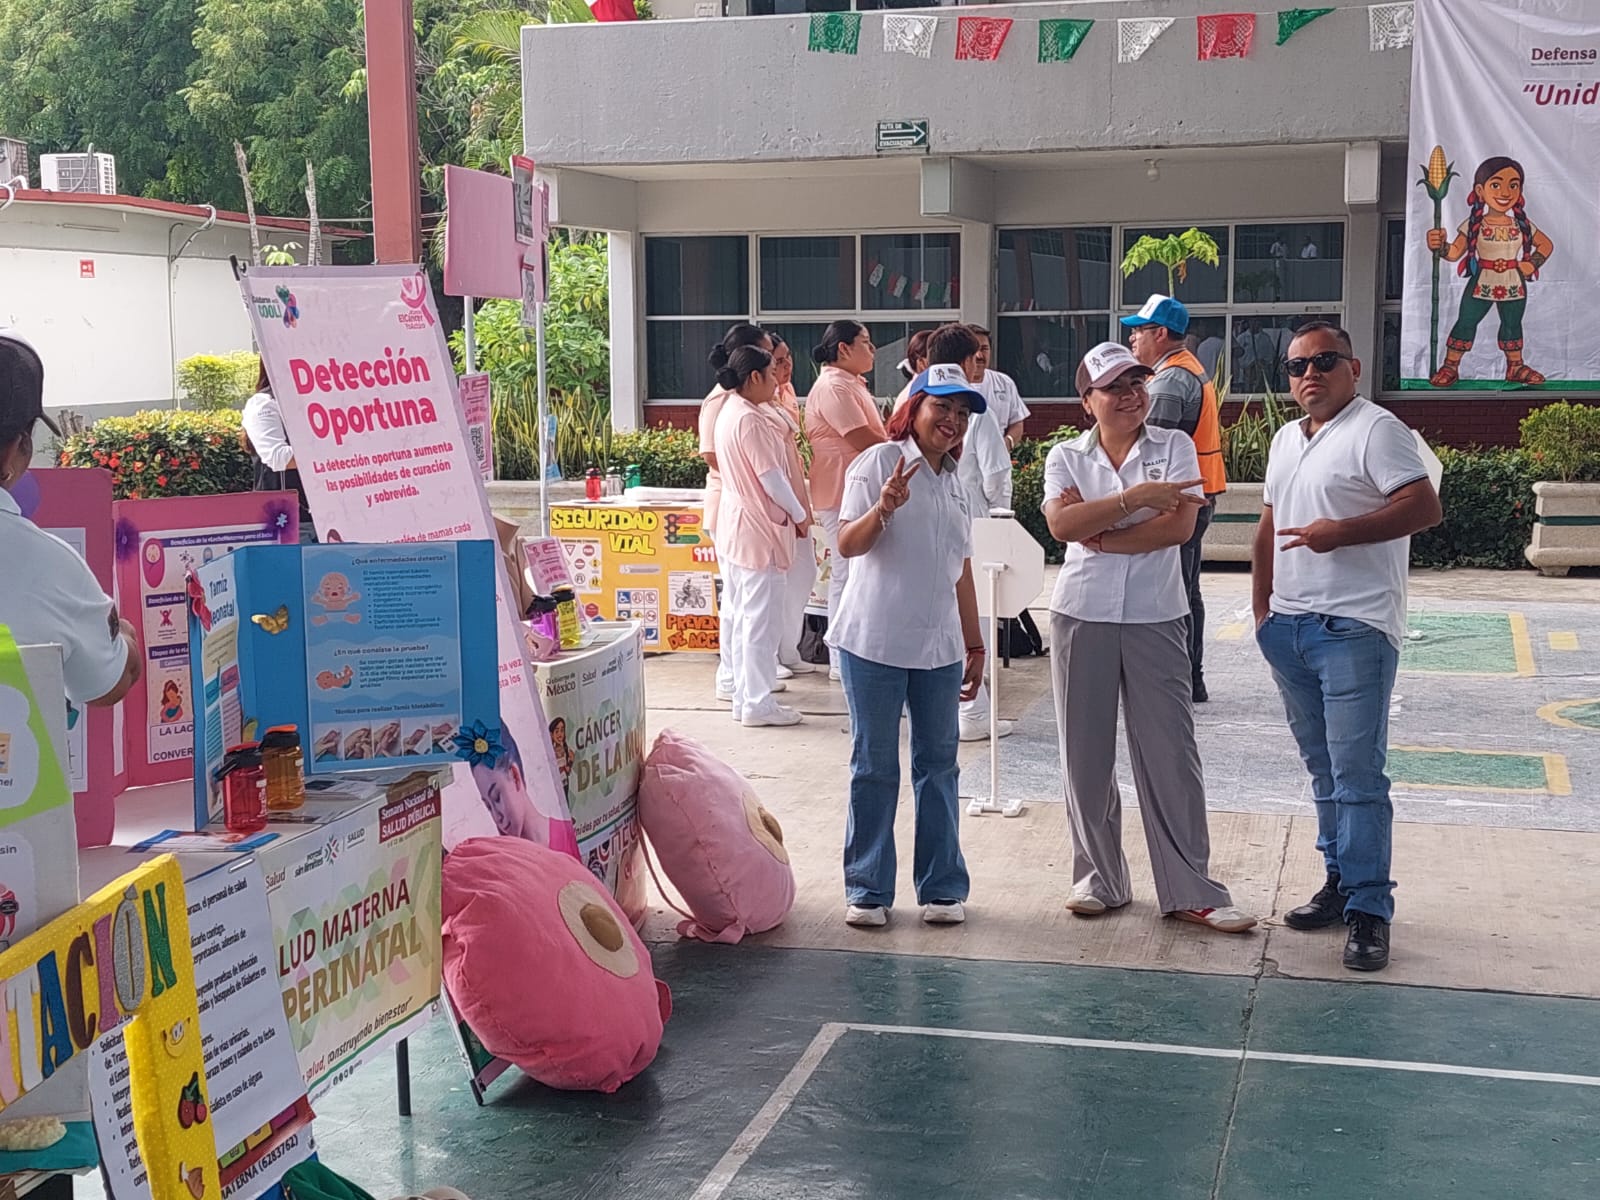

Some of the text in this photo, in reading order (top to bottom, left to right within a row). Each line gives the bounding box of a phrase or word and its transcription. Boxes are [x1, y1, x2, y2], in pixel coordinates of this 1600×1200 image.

[1531, 48, 1597, 61] Defensa
[289, 347, 430, 394] Detección
[307, 397, 437, 445] Oportuna
[314, 441, 453, 474] La detección oportuna aumenta
[326, 459, 451, 492] las posibilidades de curación
[366, 484, 420, 507] y sobrevida.
[454, 522, 472, 534] cada
[551, 508, 658, 531] SEGURIDAD
[608, 532, 656, 556] VIAL
[210, 573, 228, 599] Tamiz
[212, 600, 235, 627] eonatal
[667, 632, 688, 650] DE
[510, 659, 523, 671] vez
[510, 674, 522, 684] los
[546, 681, 576, 698] México
[160, 724, 194, 736] LA LAC
[576, 710, 622, 750] CÁNCER
[153, 746, 194, 761] CONVER
[578, 753, 600, 792] DE
[605, 742, 622, 778] LA
[381, 804, 405, 822] Semana
[404, 790, 428, 812] Nacional
[381, 820, 406, 839] SALUD
[408, 802, 436, 826] PÚBLICA
[347, 828, 365, 844] SALUD
[266, 866, 286, 890] Salud
[208, 888, 228, 910] personal
[228, 886, 234, 894] de
[234, 877, 248, 892] salud
[222, 933, 240, 949] además
[240, 928, 246, 938] de
[280, 878, 410, 977] LUD MATERNA
[232, 967, 238, 977] de
[241, 972, 260, 989] Diabetes
[282, 915, 422, 1024] PERINATAL
[263, 1027, 276, 1041] fecha
[326, 1021, 372, 1066] construyendo
[258, 1134, 298, 1171] (6283762)
